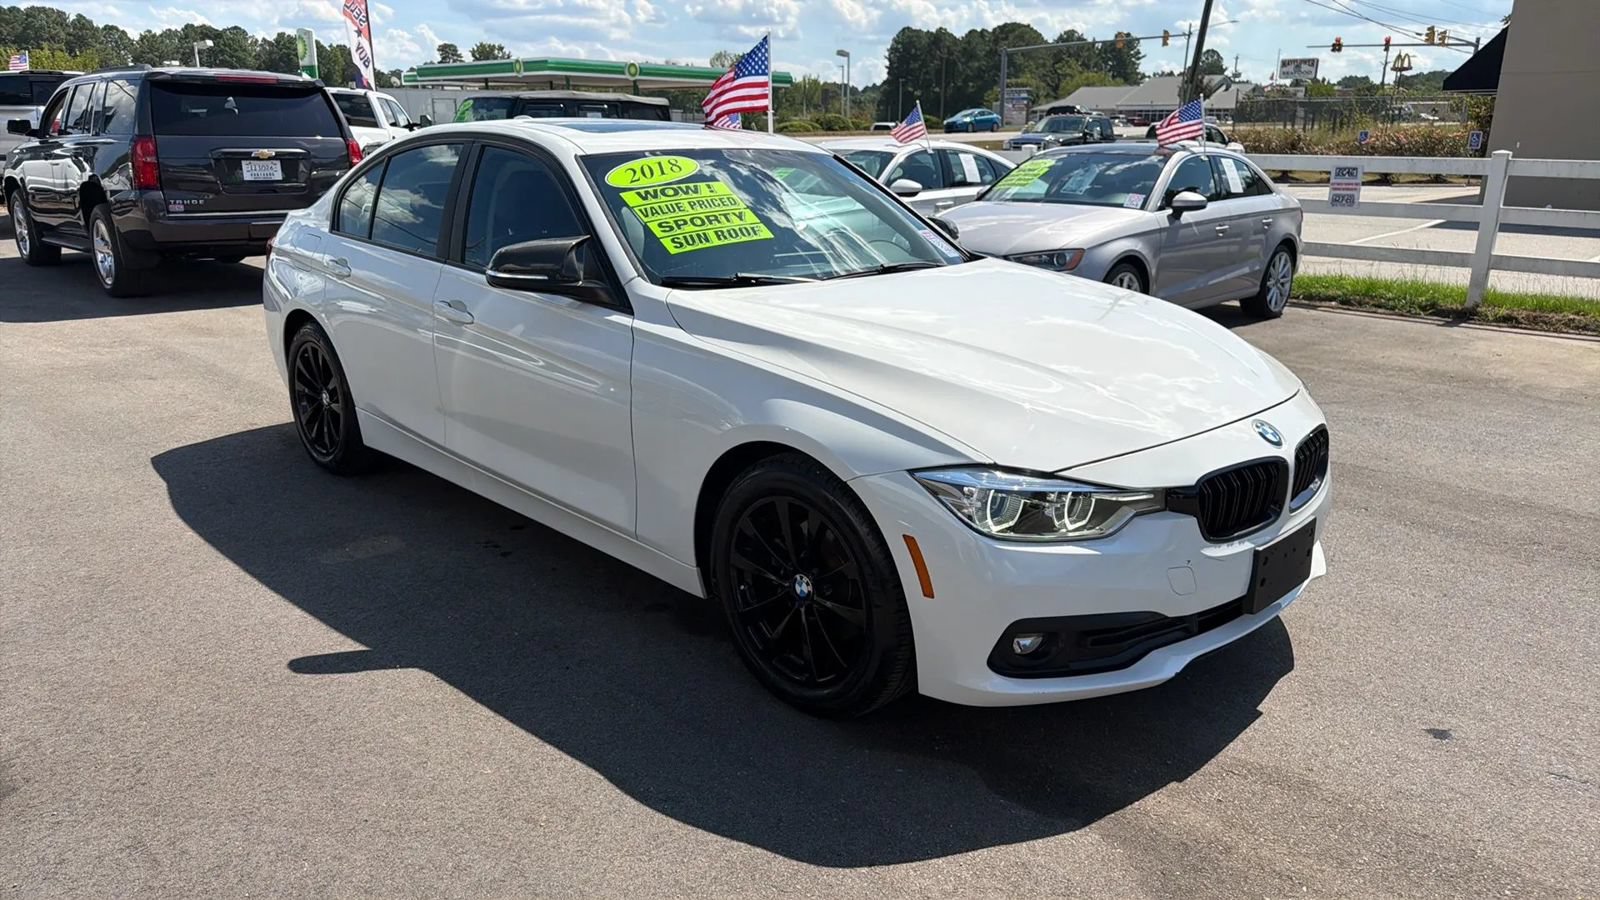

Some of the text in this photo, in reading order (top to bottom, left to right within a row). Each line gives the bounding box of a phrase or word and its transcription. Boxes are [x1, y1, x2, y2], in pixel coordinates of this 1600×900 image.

[625, 158, 682, 184] 2018
[636, 184, 701, 202] WOW
[638, 196, 739, 219] VALUE PRICED
[657, 211, 746, 233] SPORTY
[670, 226, 762, 250] SUN ROOF
